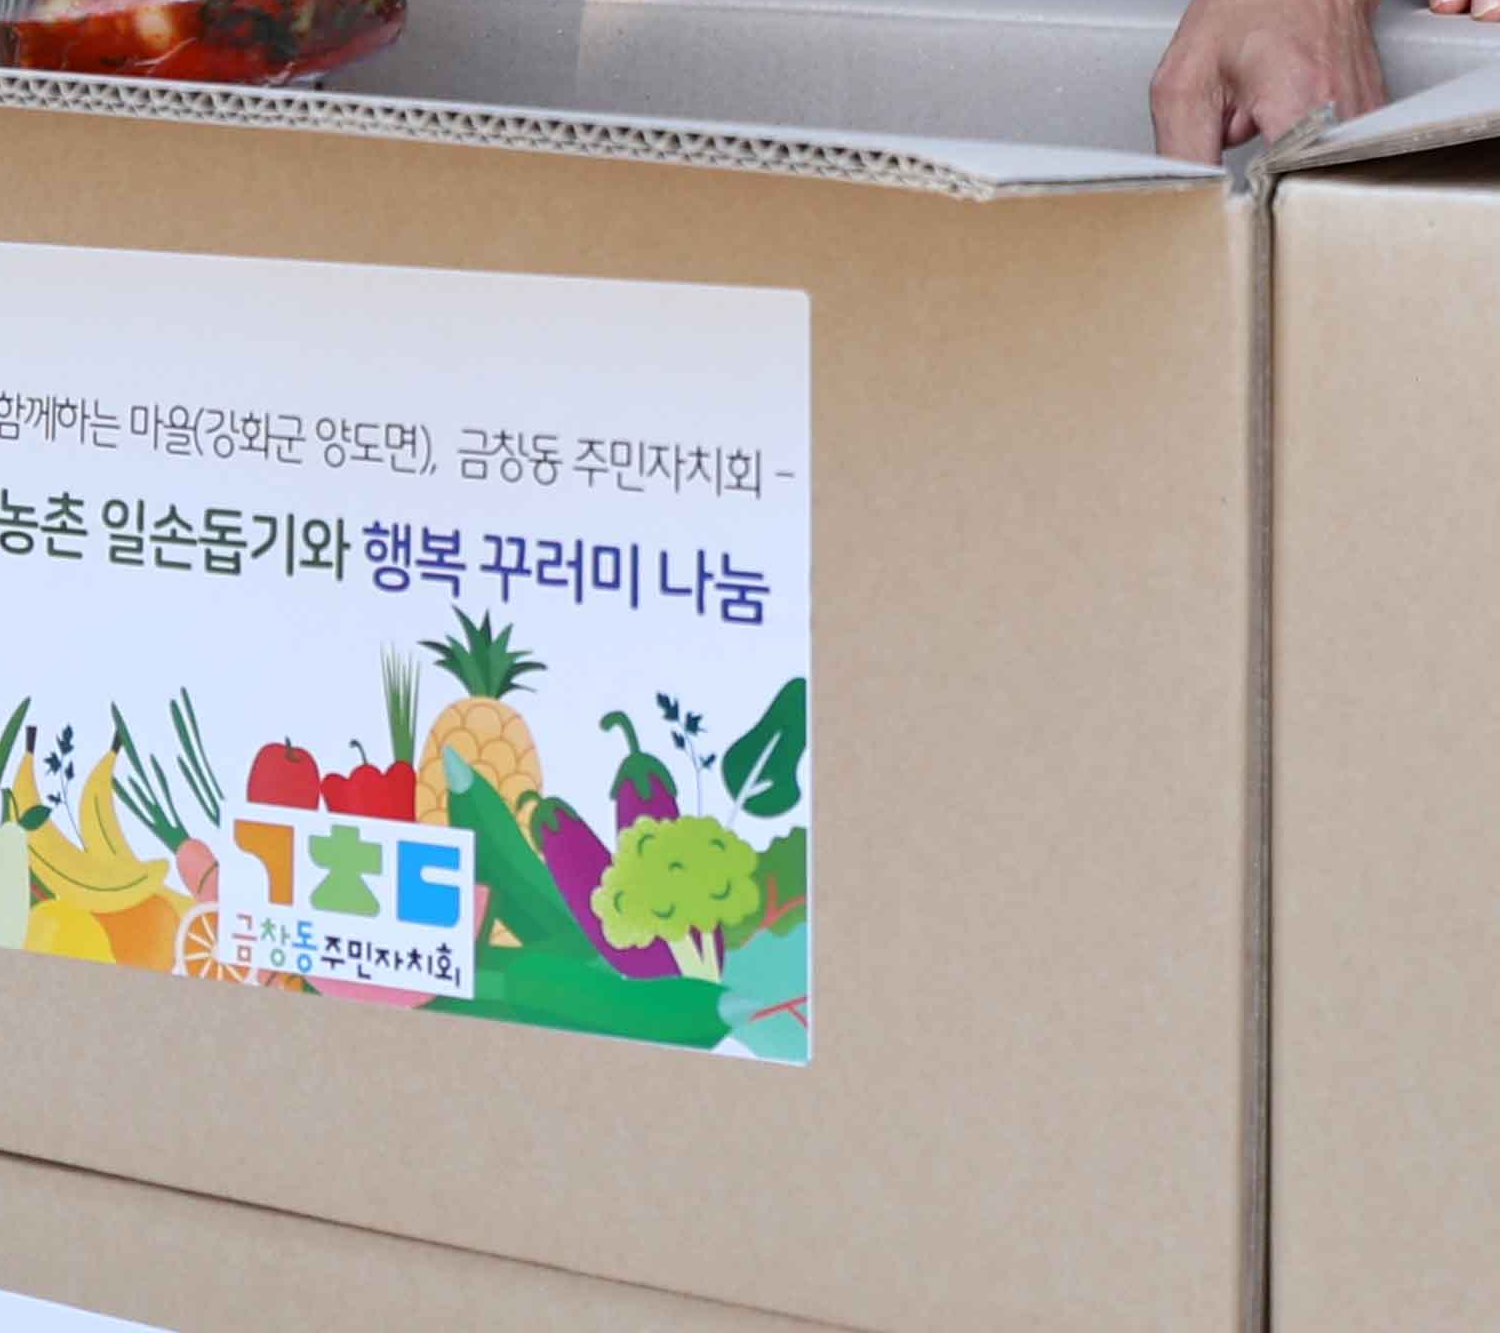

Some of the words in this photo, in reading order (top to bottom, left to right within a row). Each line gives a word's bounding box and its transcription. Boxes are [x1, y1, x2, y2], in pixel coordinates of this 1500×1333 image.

[130, 404, 307, 465] 마을(강화군
[457, 428, 564, 487] 금창동
[573, 438, 762, 500] 주민자치회
[101, 498, 352, 582] 일손돕기와
[362, 520, 467, 598] 행복
[479, 534, 640, 610] 꾸러미
[659, 548, 771, 626] 나눔
